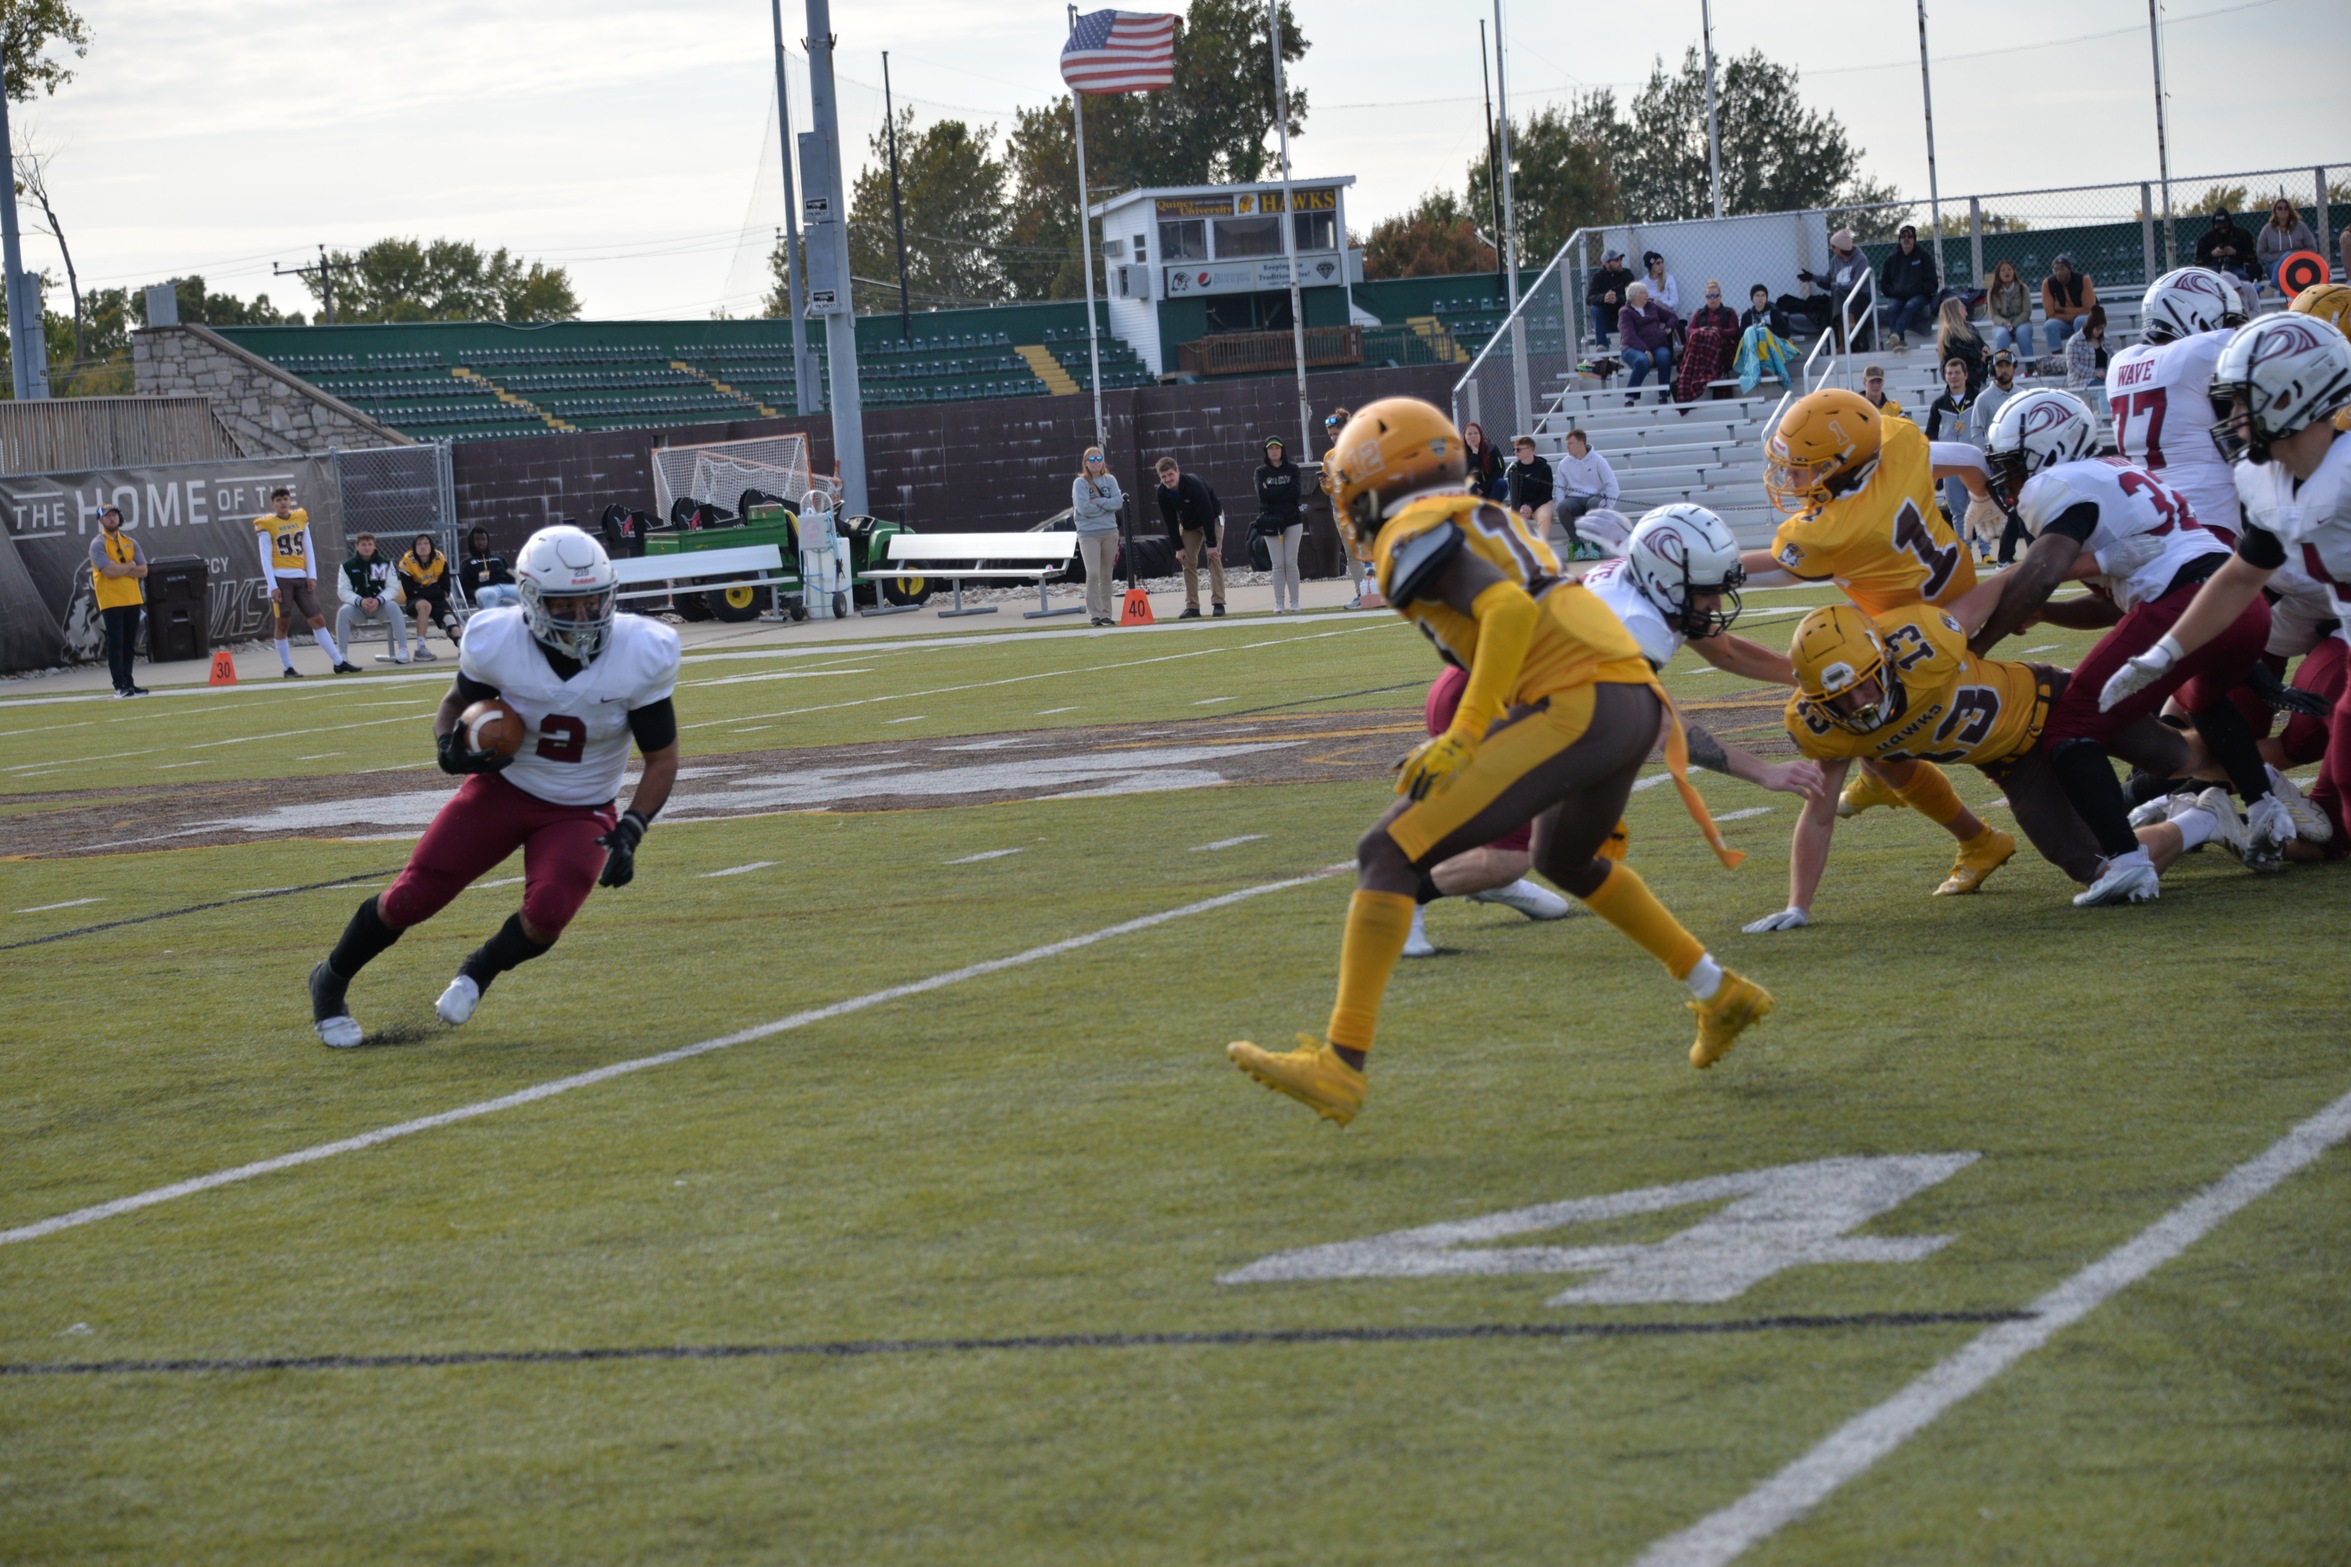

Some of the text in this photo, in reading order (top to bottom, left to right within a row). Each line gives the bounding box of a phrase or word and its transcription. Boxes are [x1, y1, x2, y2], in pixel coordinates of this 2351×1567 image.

[1156, 200, 1194, 212] Quincy
[1180, 205, 1233, 216] University
[2117, 360, 2155, 387] WAVE
[1829, 421, 1850, 446] 1
[2110, 387, 2167, 470] 77
[1348, 439, 1387, 483] 12
[13, 480, 298, 535] THE HOME OF TE
[1471, 502, 1579, 603] 1
[1892, 497, 1961, 601] 1
[370, 563, 388, 581] M
[571, 577, 597, 585] Riddell
[1129, 599, 1146, 618] 40
[216, 660, 231, 679] 30
[536, 713, 587, 763] 2
